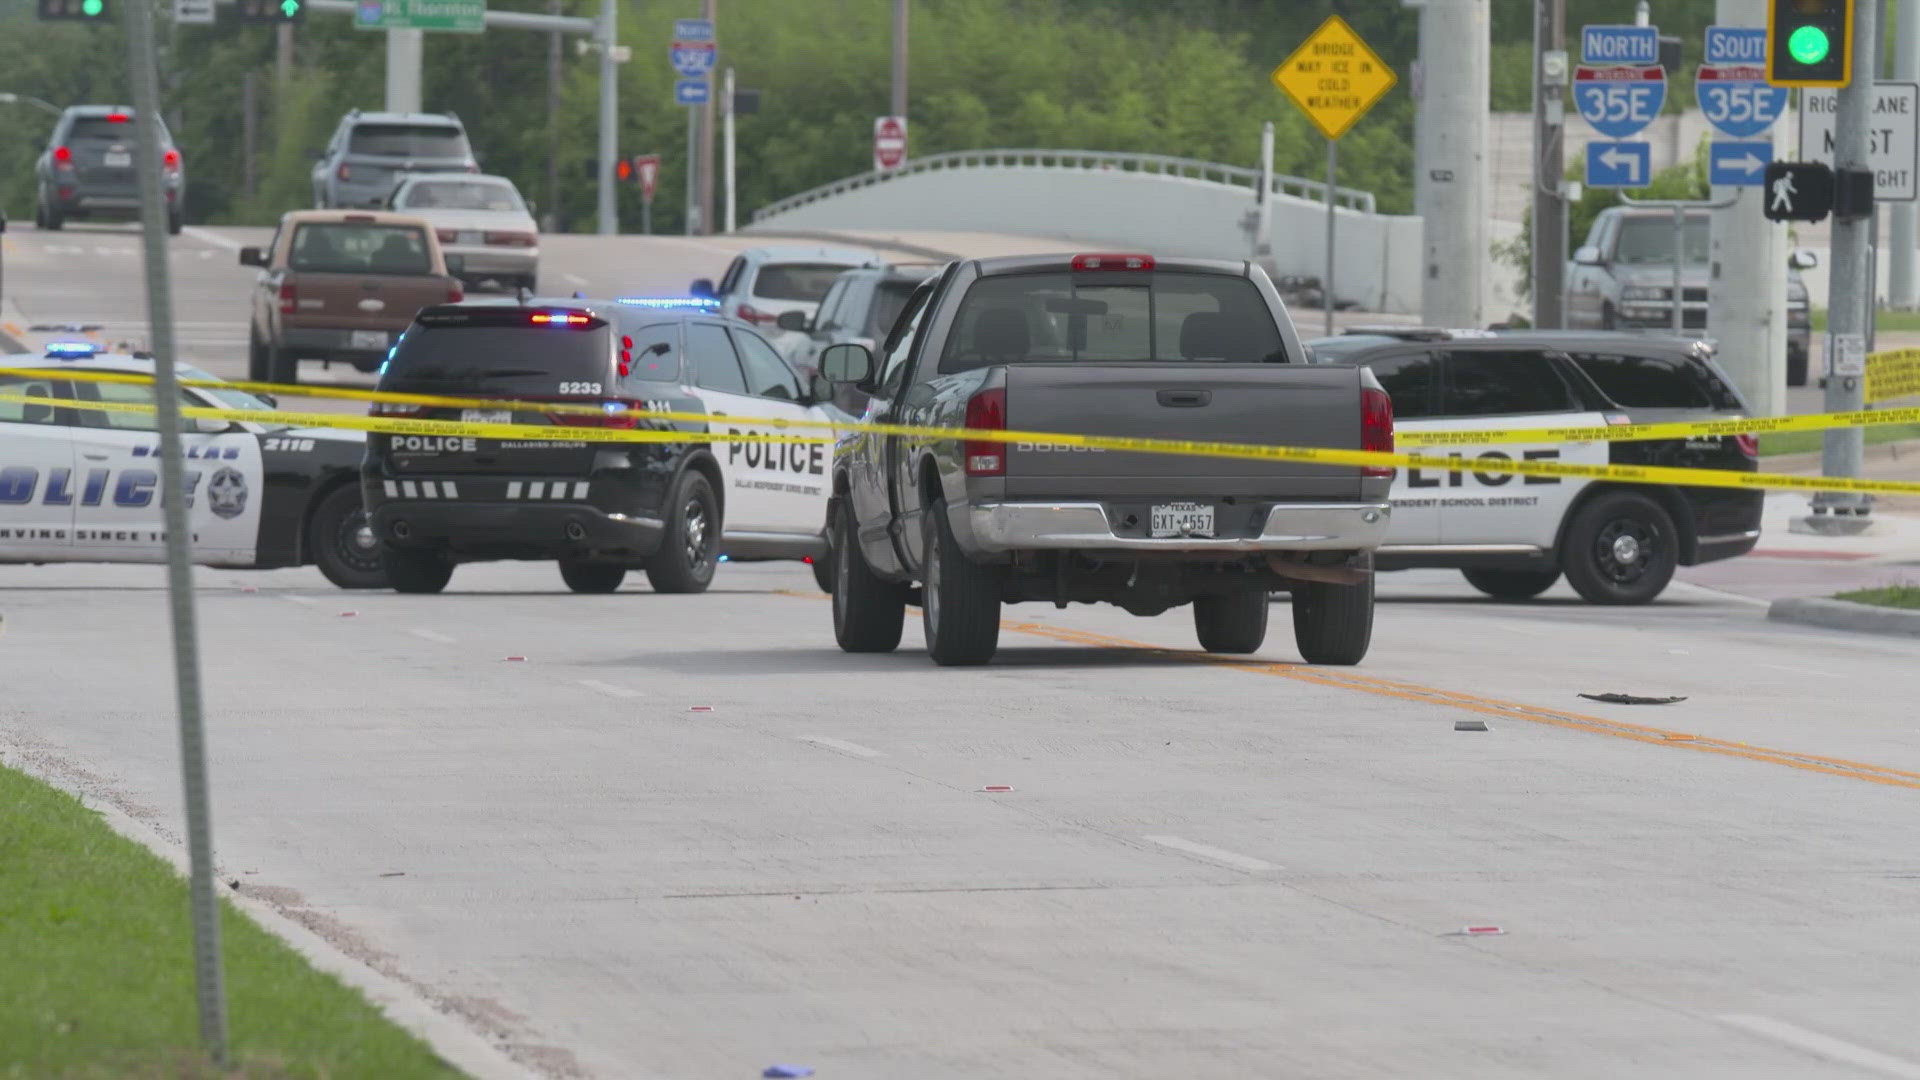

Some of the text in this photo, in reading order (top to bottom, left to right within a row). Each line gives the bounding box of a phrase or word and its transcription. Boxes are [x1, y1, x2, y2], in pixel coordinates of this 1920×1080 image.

[1313, 43, 1355, 56] BRIDGE
[1587, 32, 1654, 58] NORTH
[1296, 62, 1321, 73] MAY
[1318, 79, 1351, 91] COLD
[1308, 96, 1360, 109] WEATHER
[1583, 87, 1651, 123] 35E
[1707, 87, 1775, 123] 35E
[1808, 96, 1909, 114] RIG ANE
[1823, 128, 1894, 154] MT
[1876, 170, 1908, 187] GHT
[559, 381, 602, 396] 5233
[391, 435, 478, 452] POLICE
[728, 428, 824, 475] POLICE
[131, 446, 240, 459] DALAS
[1391, 450, 1561, 489] LICE
[1441, 498, 1486, 507] SCHOOL
[1488, 497, 1538, 506] DISTRICT
[77, 531, 140, 542] SINCE
